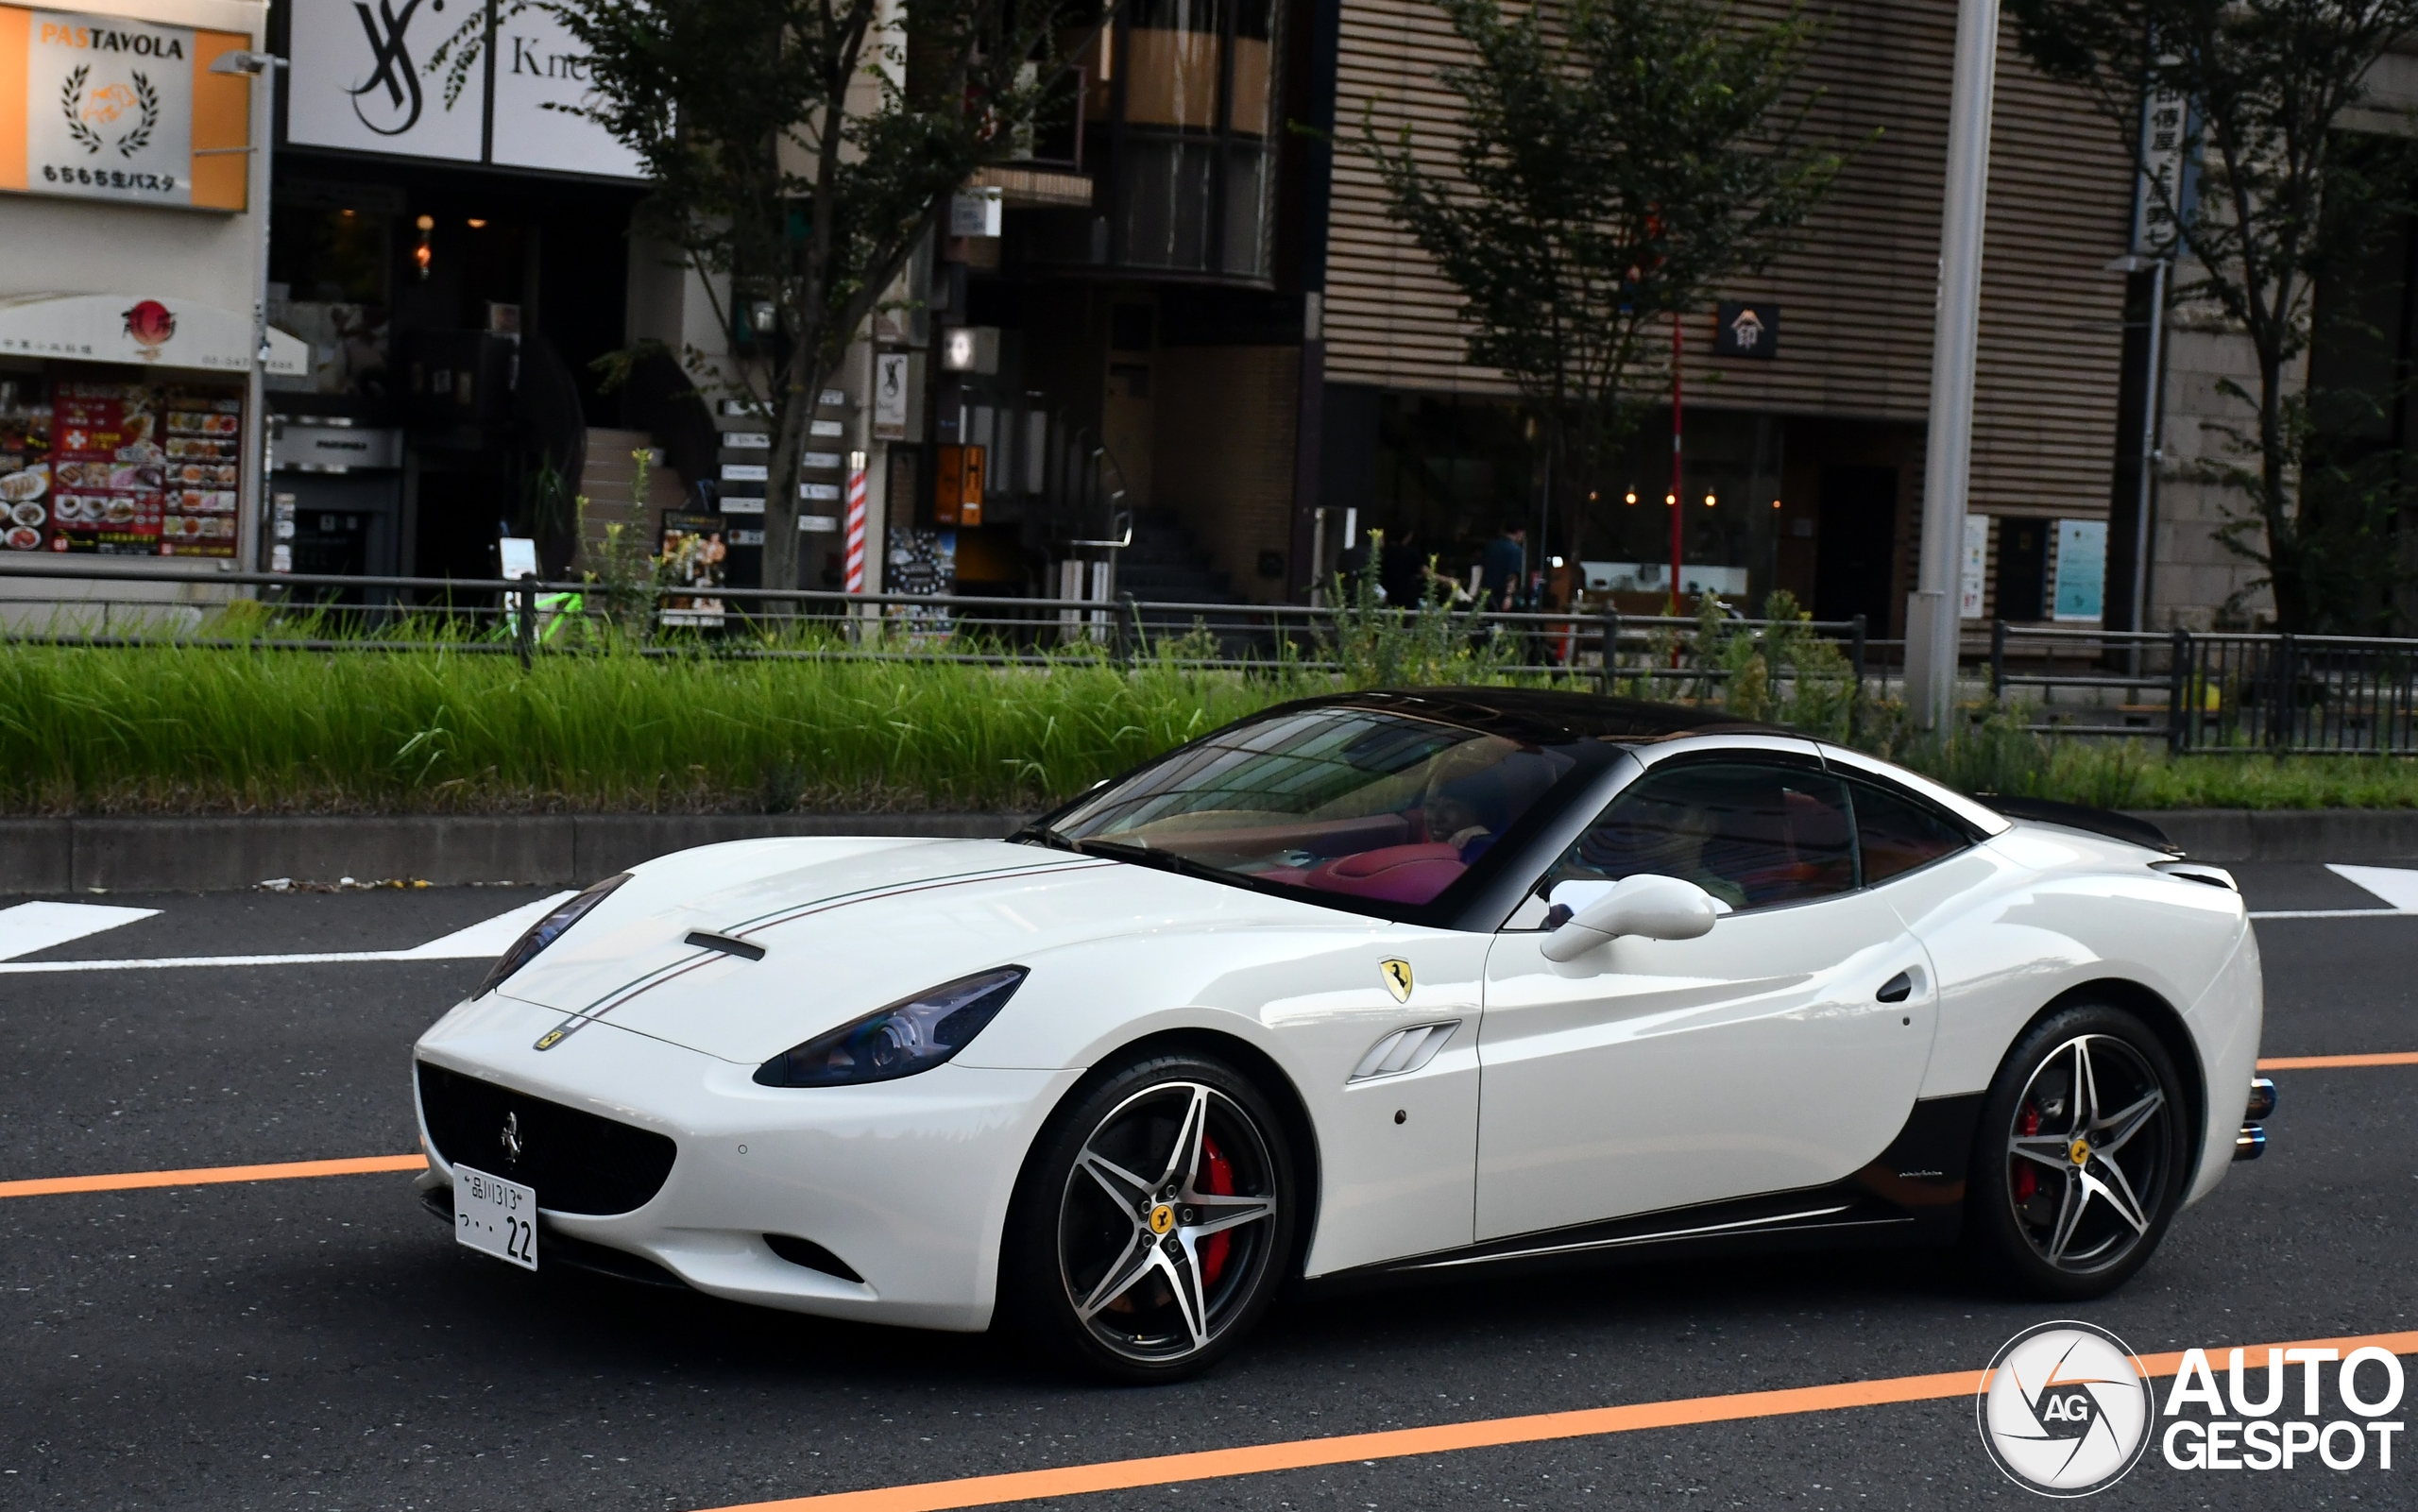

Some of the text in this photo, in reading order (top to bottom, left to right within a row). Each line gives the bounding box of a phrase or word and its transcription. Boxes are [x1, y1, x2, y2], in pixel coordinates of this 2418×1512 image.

[41, 22, 183, 59] PASTAVOLA
[43, 163, 175, 193] もちもち生パスタ
